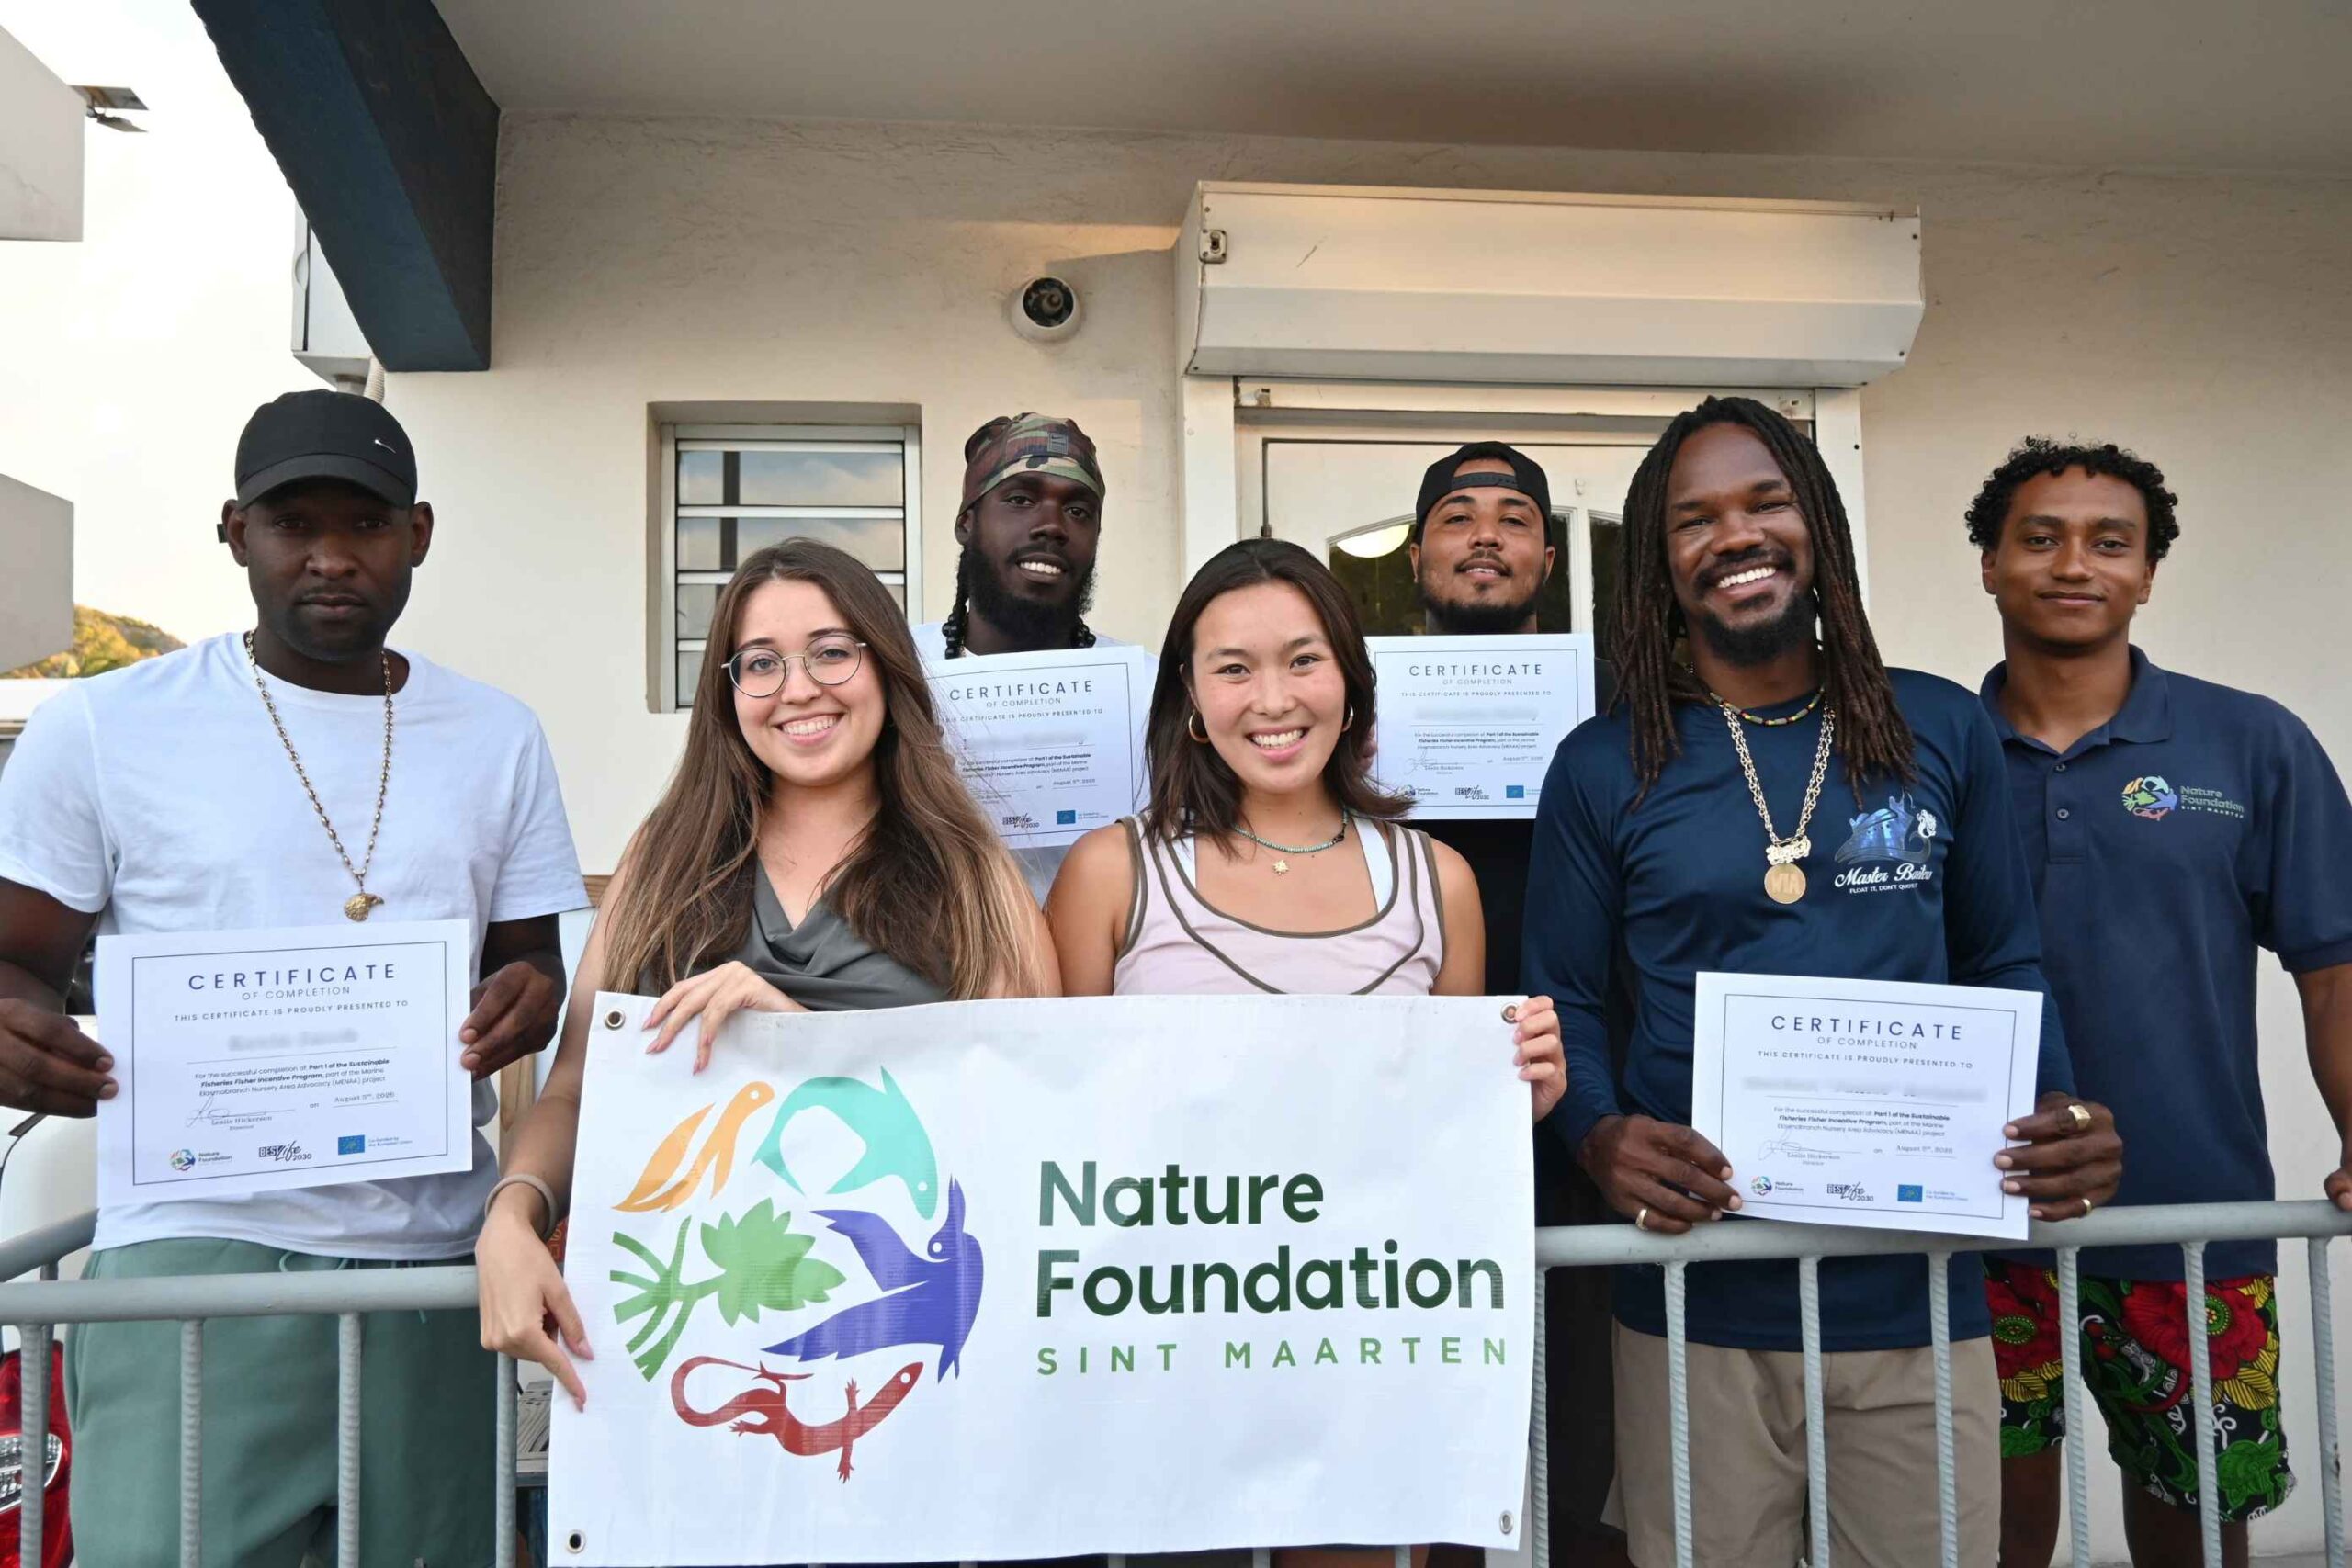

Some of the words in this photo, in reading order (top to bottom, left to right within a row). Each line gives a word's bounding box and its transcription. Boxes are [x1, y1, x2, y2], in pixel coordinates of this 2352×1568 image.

[1409, 664, 1542, 677] CERTIFICATE
[949, 680, 1092, 701] CERTIFICATE
[1002, 697, 1061, 707] COMPLETION
[960, 714, 1006, 722] CERTIFICATE
[2180, 785, 2222, 798] Nature
[2180, 795, 2245, 813] Foundation
[1834, 866, 1889, 887] Master
[188, 964, 396, 990] CERTIFICATE
[243, 991, 258, 1000] OF
[266, 987, 350, 999] COMPLETION
[202, 1010, 269, 1021] CERTIFICATE
[288, 1005, 333, 1014] PROUDLY
[337, 1000, 391, 1011] PRESENTED
[1771, 1015, 1962, 1040] CERTIFICATE
[1817, 1036, 1832, 1044] OF
[1838, 1037, 1917, 1050] COMPLETION
[1782, 1052, 1840, 1061] CERTIFICATE
[1857, 1055, 1899, 1064] PROUDLY
[1903, 1057, 1956, 1068] PRESENTED
[292, 1154, 312, 1162] 2030
[1038, 1161, 1324, 1227] Nature
[1036, 1239, 1505, 1318] Foundation
[1036, 1343, 1178, 1375] SINT
[1226, 1337, 1506, 1369] MAARTEN
